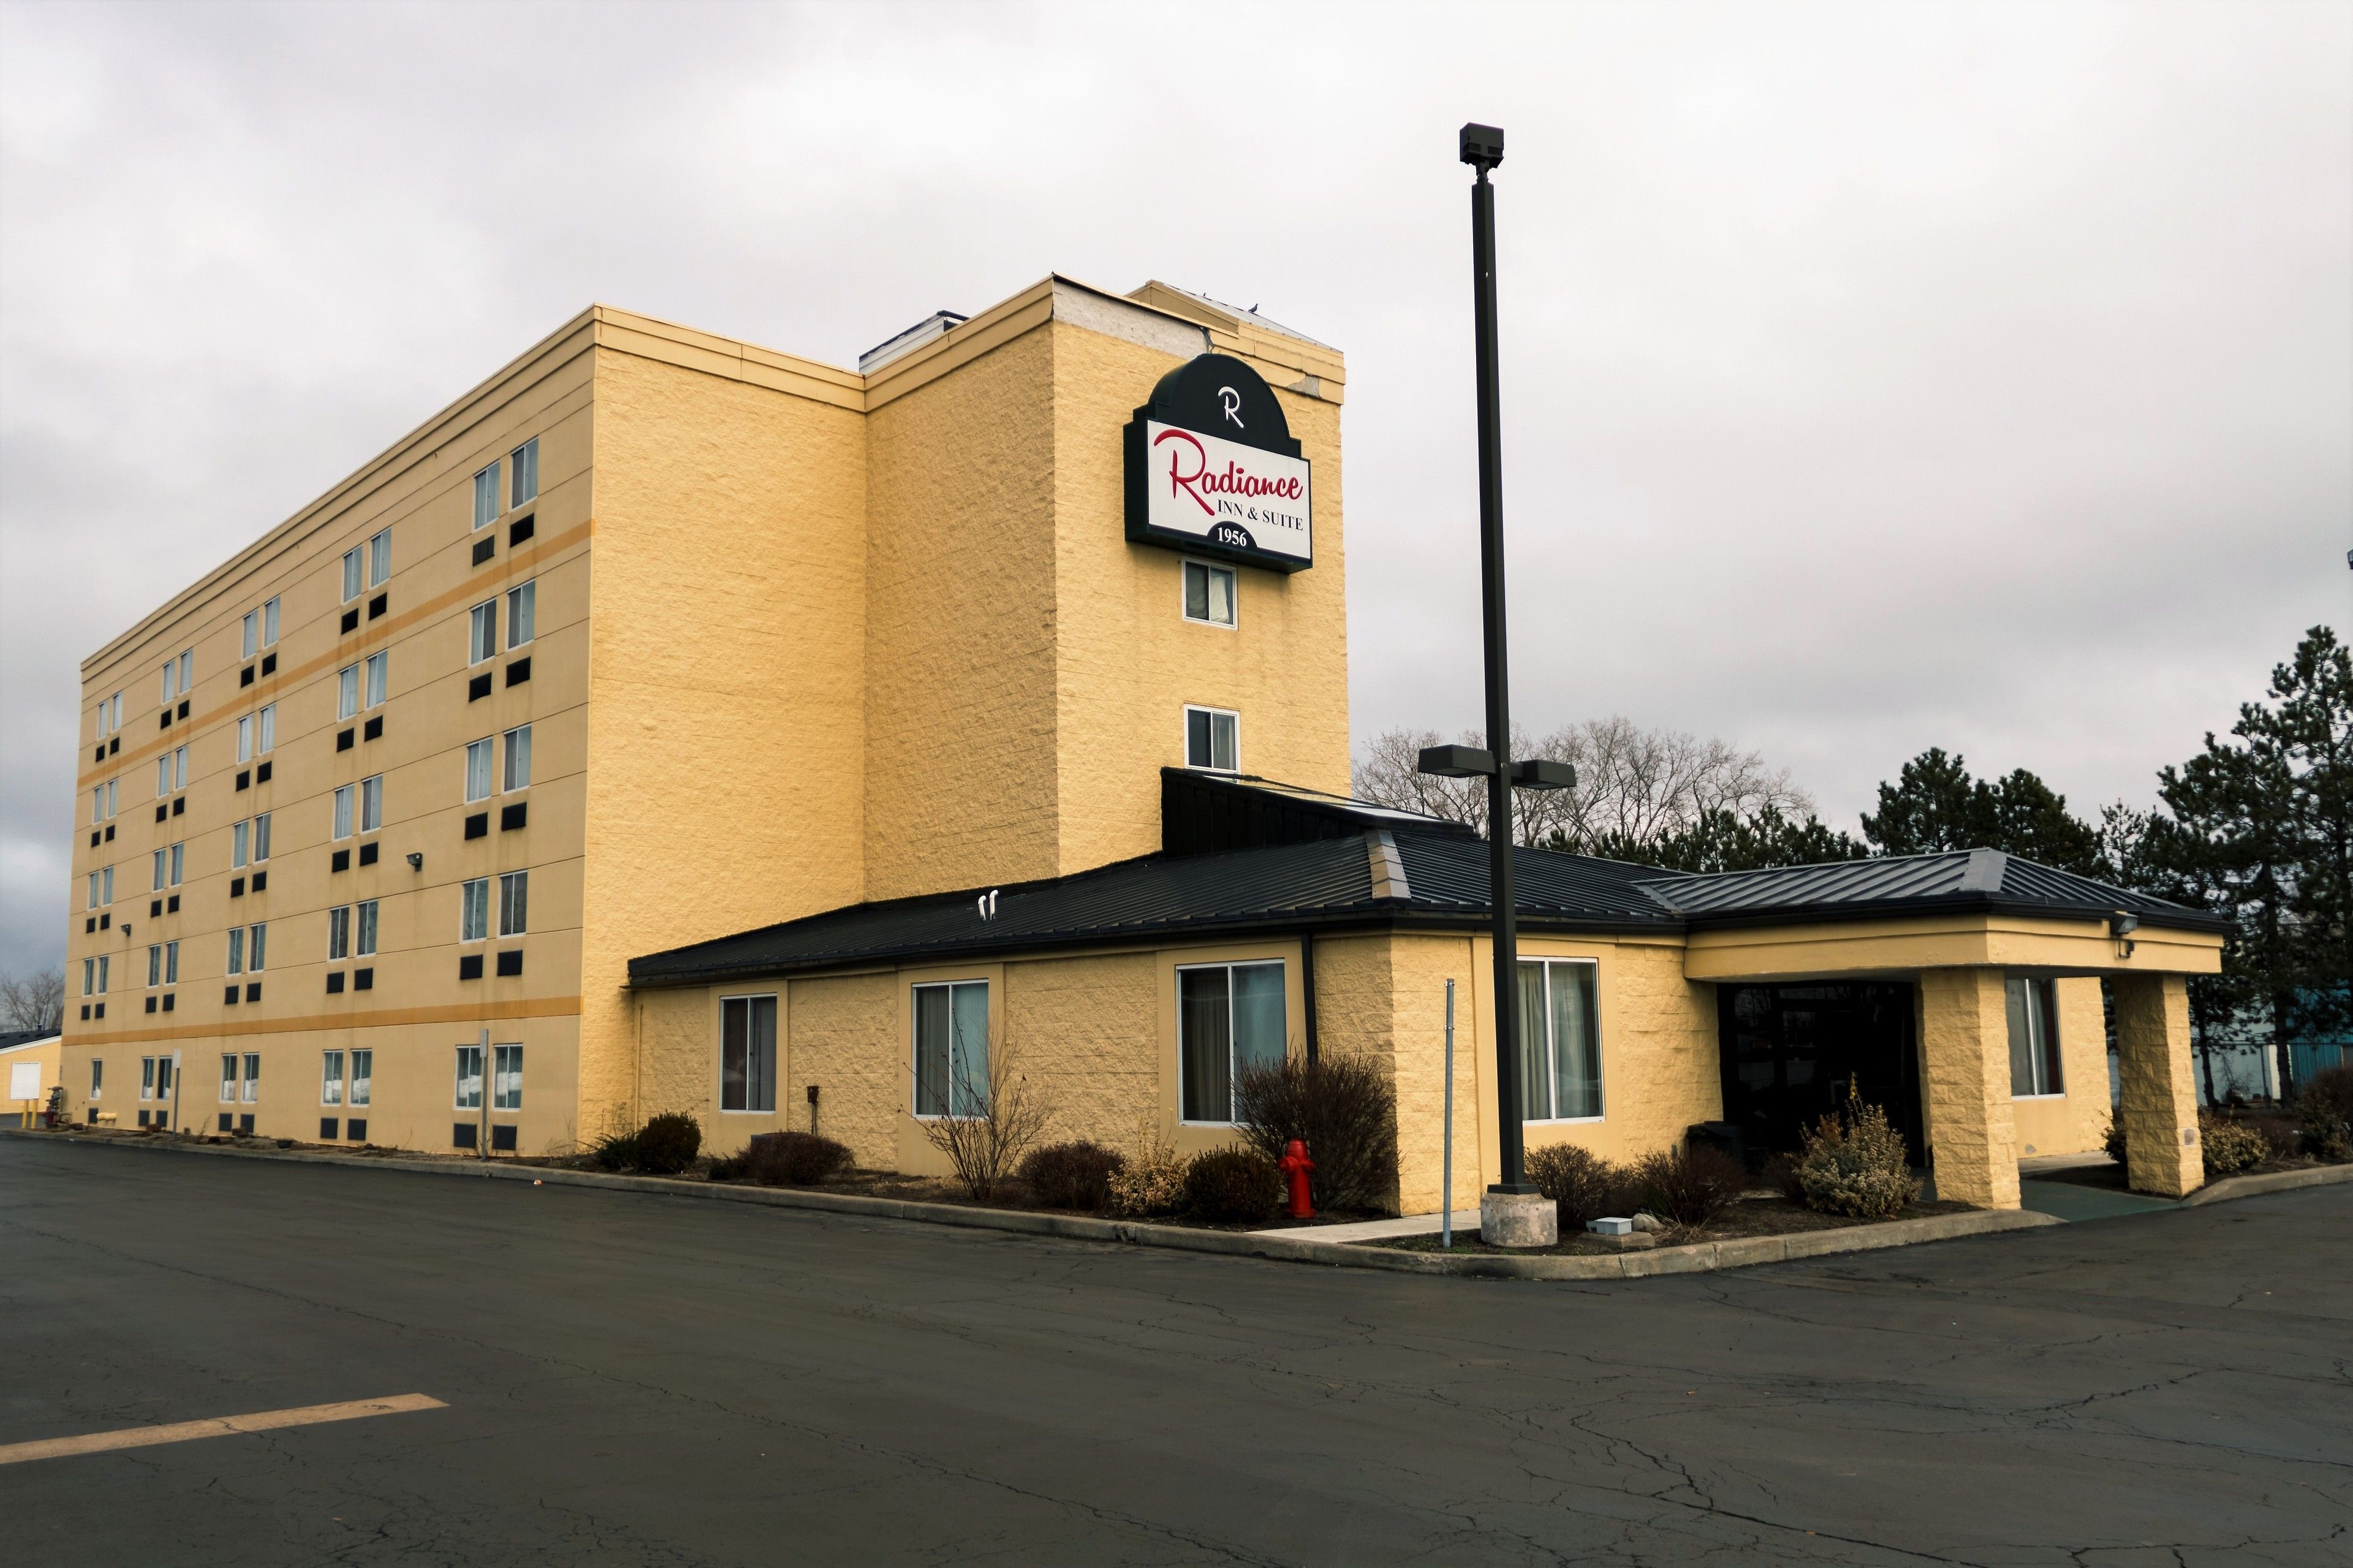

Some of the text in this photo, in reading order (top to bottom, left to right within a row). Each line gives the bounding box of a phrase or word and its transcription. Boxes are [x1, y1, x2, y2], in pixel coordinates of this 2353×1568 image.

[1218, 386, 1245, 428] R
[1153, 429, 1303, 517] Radiance
[1218, 499, 1303, 531] INN & SUITE
[1217, 527, 1247, 547] 1956
